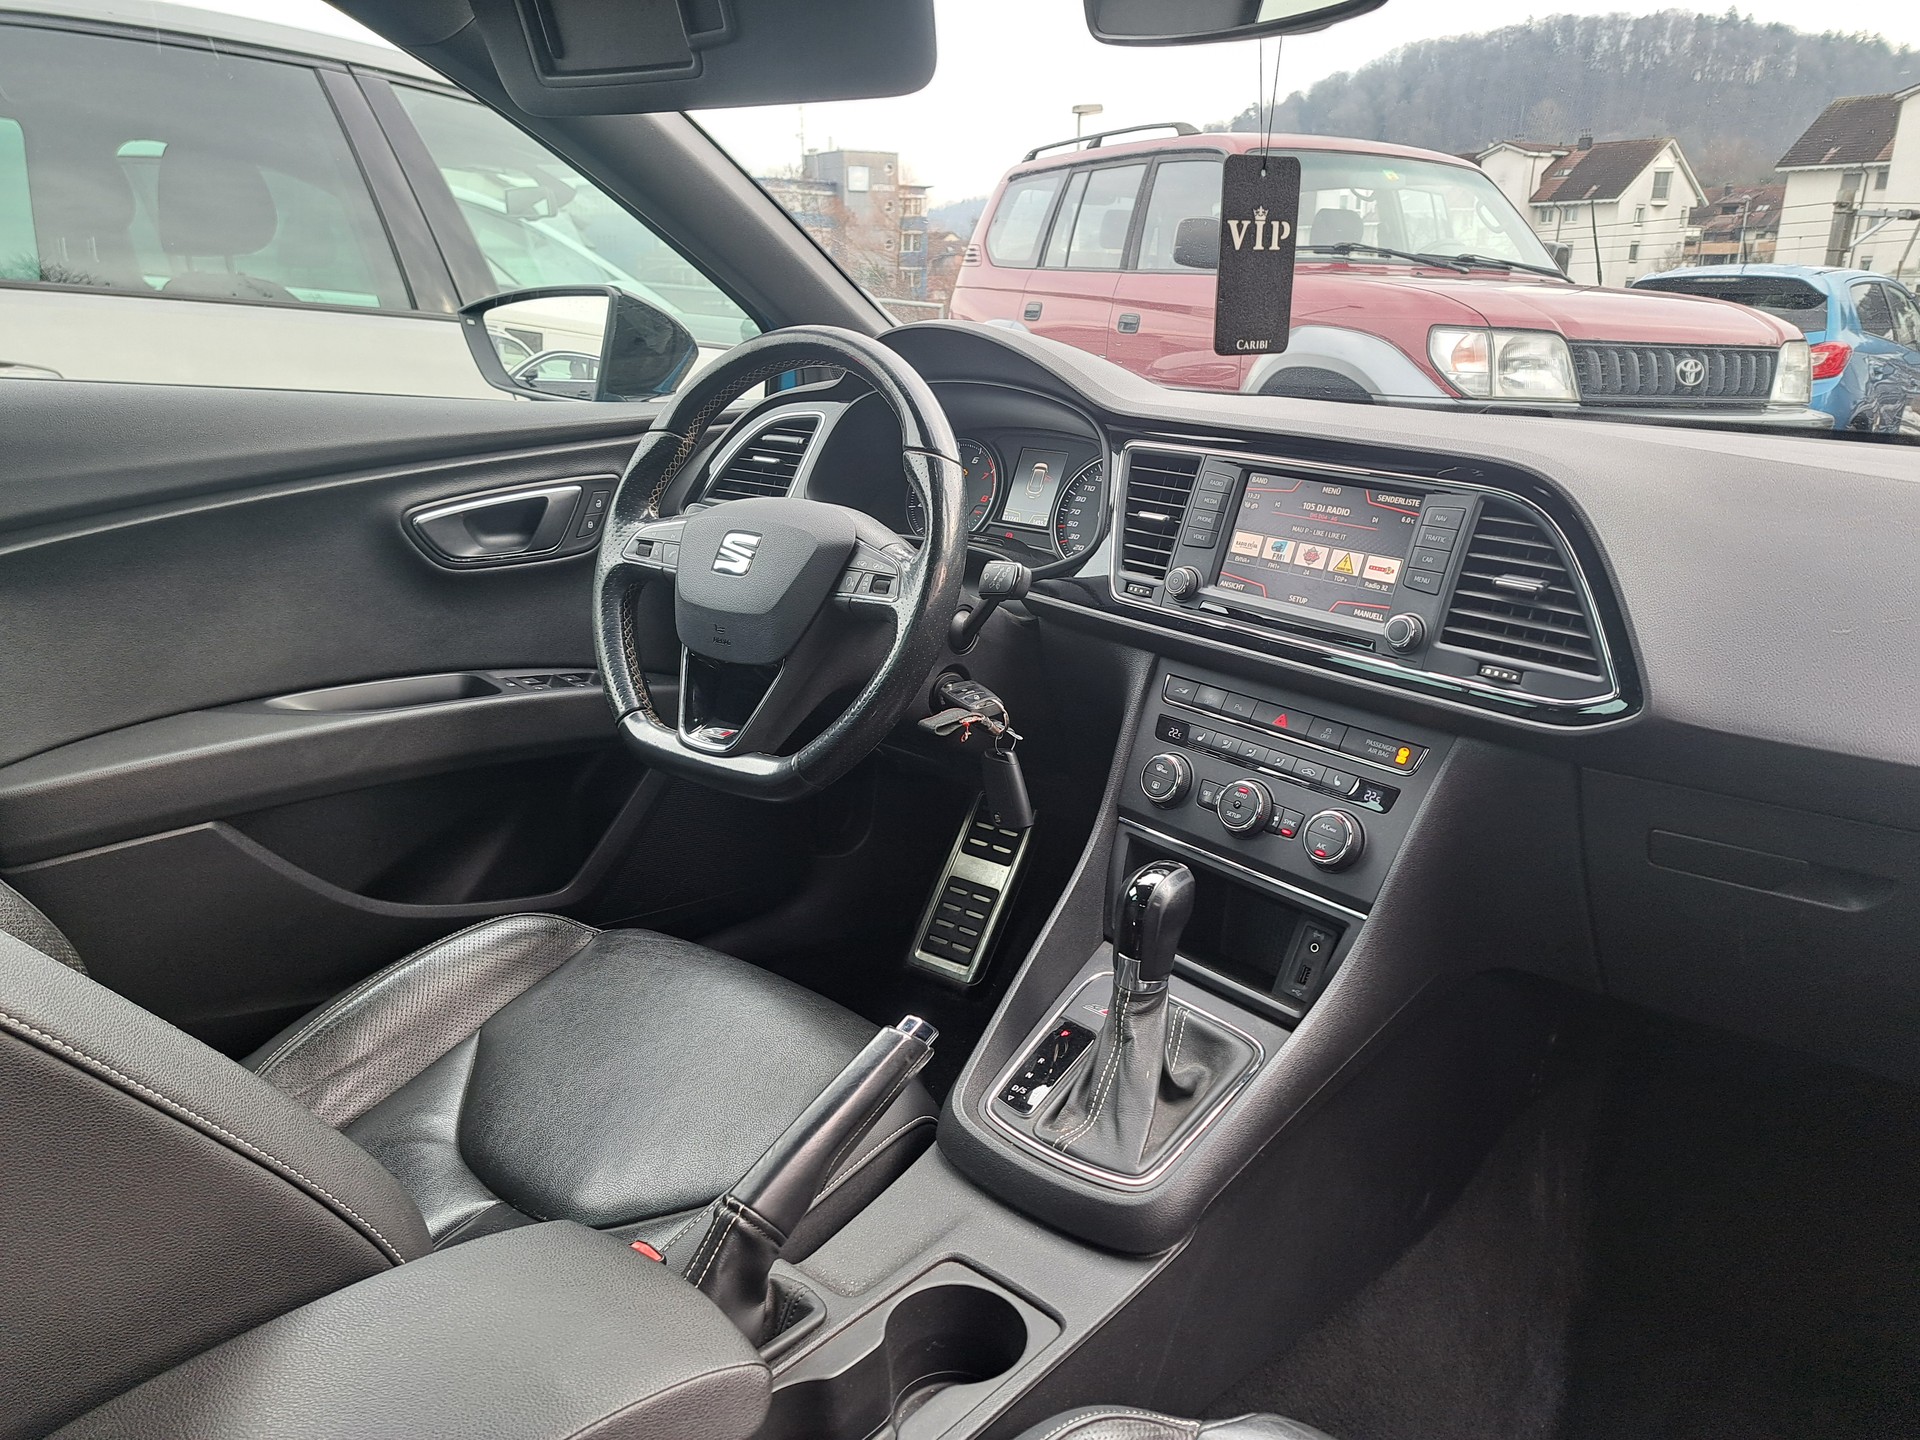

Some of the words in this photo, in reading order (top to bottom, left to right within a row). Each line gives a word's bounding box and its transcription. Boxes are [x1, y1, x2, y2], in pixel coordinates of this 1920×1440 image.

[1227, 220, 1291, 251] VIP
[1236, 340, 1269, 350] CARIBI
[1251, 476, 1269, 485] BAND
[1322, 486, 1341, 495] MENÜ
[1247, 492, 1261, 500] 13:23
[1377, 494, 1421, 507] SENDERLISTE
[1203, 497, 1218, 505] MEDIA
[1302, 502, 1317, 512] 105
[1316, 504, 1326, 512] DJ
[1326, 506, 1351, 516] RADIO
[1197, 516, 1213, 524] PHONE
[1193, 533, 1206, 541] VOICE
[1313, 529, 1326, 537] LIKE
[1425, 533, 1447, 544] TRAFFIC
[1414, 575, 1431, 584] MENU
[1219, 580, 1245, 591] ANSICHT
[1364, 581, 1381, 589] Radio
[1288, 594, 1308, 604] SETUP
[1353, 608, 1384, 621] MANUELL
[1365, 739, 1397, 753] PASSENGER
[1368, 747, 1378, 755] AIR
[1377, 750, 1390, 758] BAG
[1234, 792, 1248, 800] AUTO
[1226, 810, 1241, 819] SETUP
[1283, 818, 1297, 828] SYNC
[1316, 842, 1327, 850] A/C
[1011, 1084, 1028, 1095] D/S
